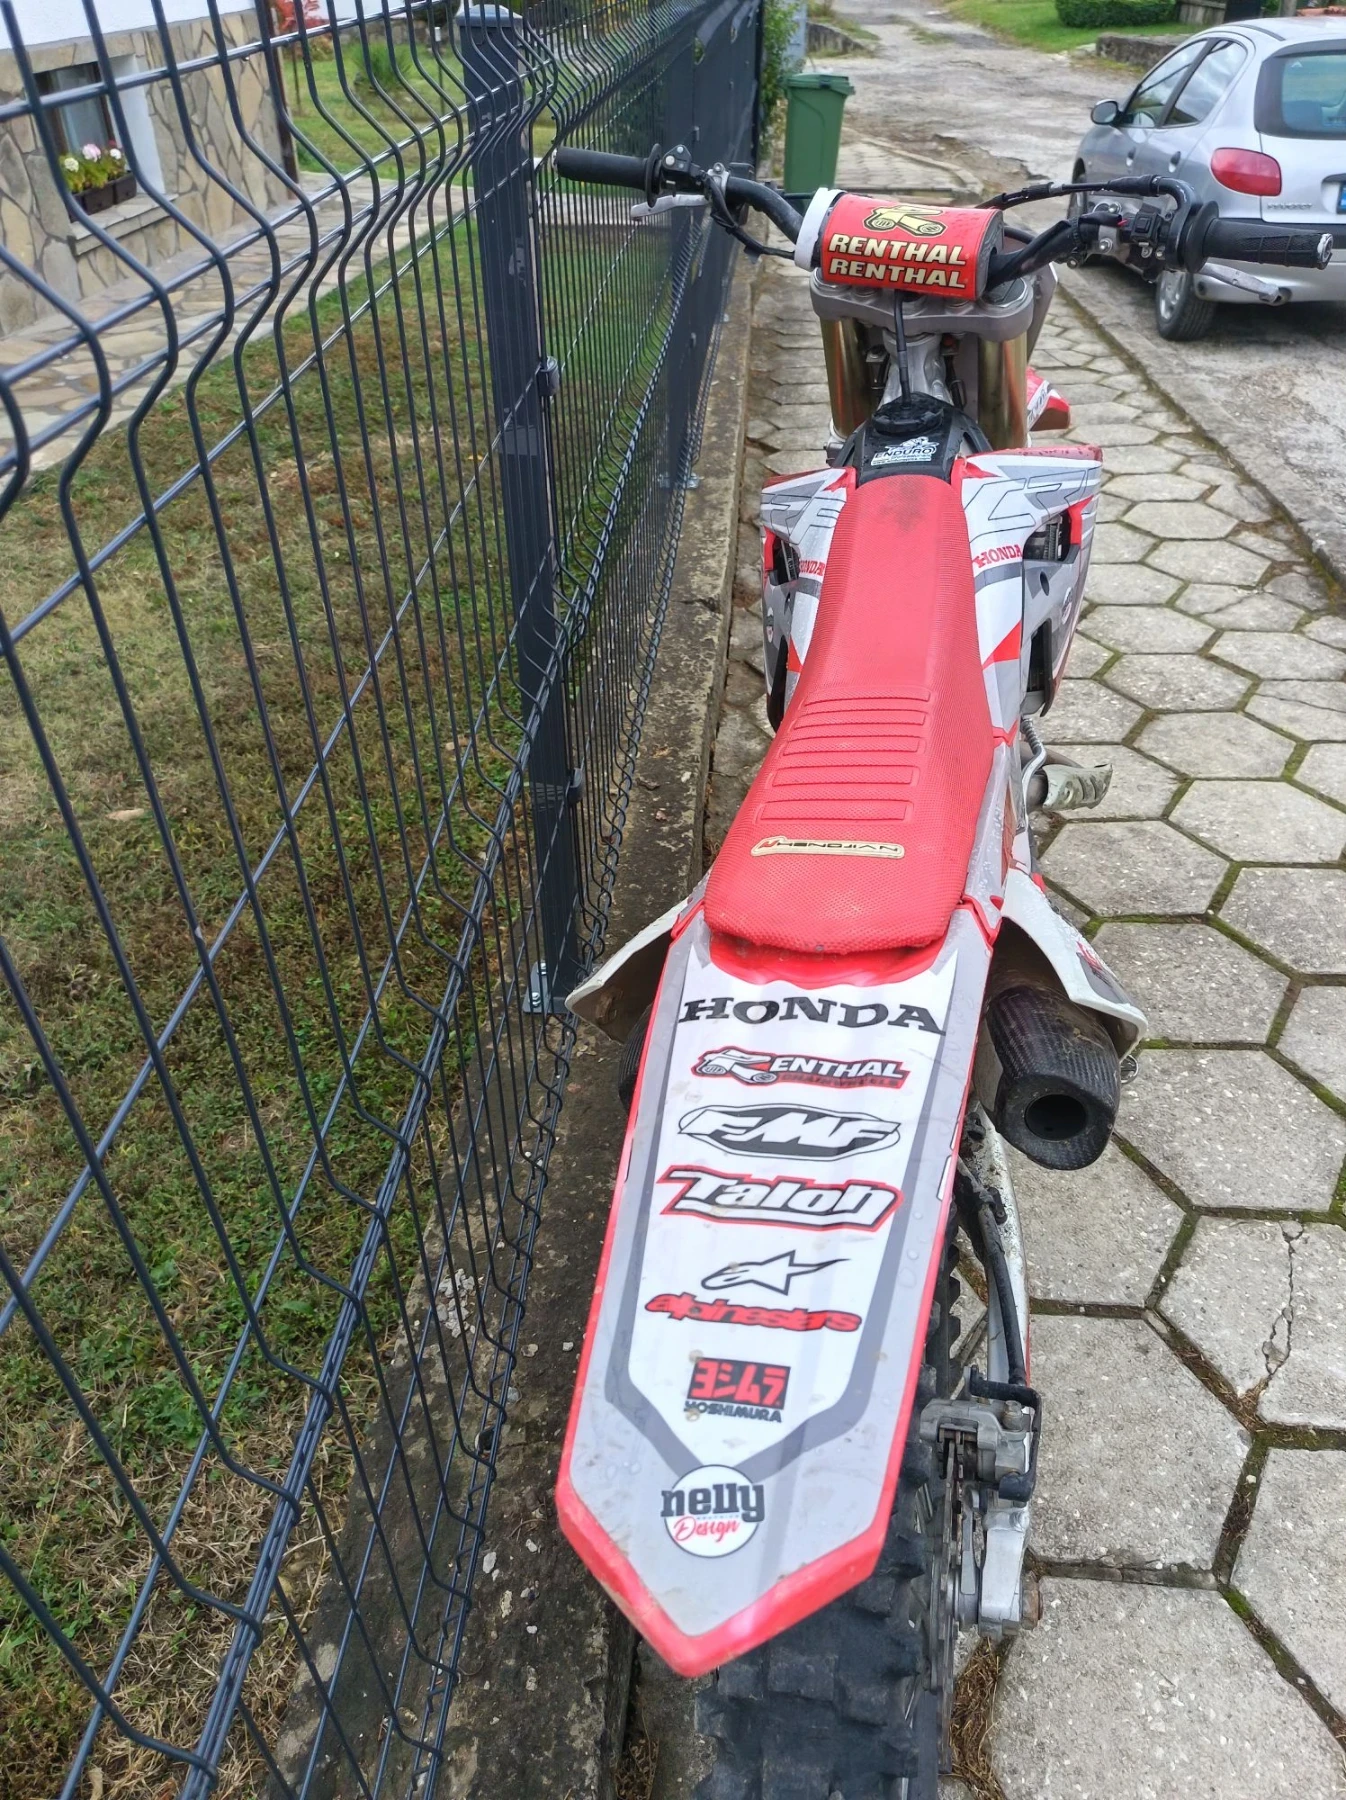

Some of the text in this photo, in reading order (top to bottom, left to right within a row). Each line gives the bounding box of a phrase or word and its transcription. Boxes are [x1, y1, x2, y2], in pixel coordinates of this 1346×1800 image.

[829, 233, 966, 265] RENTHAL
[829, 258, 965, 288] RENTHAL
[971, 544, 1022, 568] HONDA
[678, 997, 946, 1036] HONDA
[679, 1109, 901, 1152] FMF
[668, 1170, 897, 1226] Talon
[684, 1401, 782, 1423] YOSHIMURA
[661, 1483, 765, 1522] nelly
[674, 1516, 740, 1543] Design
